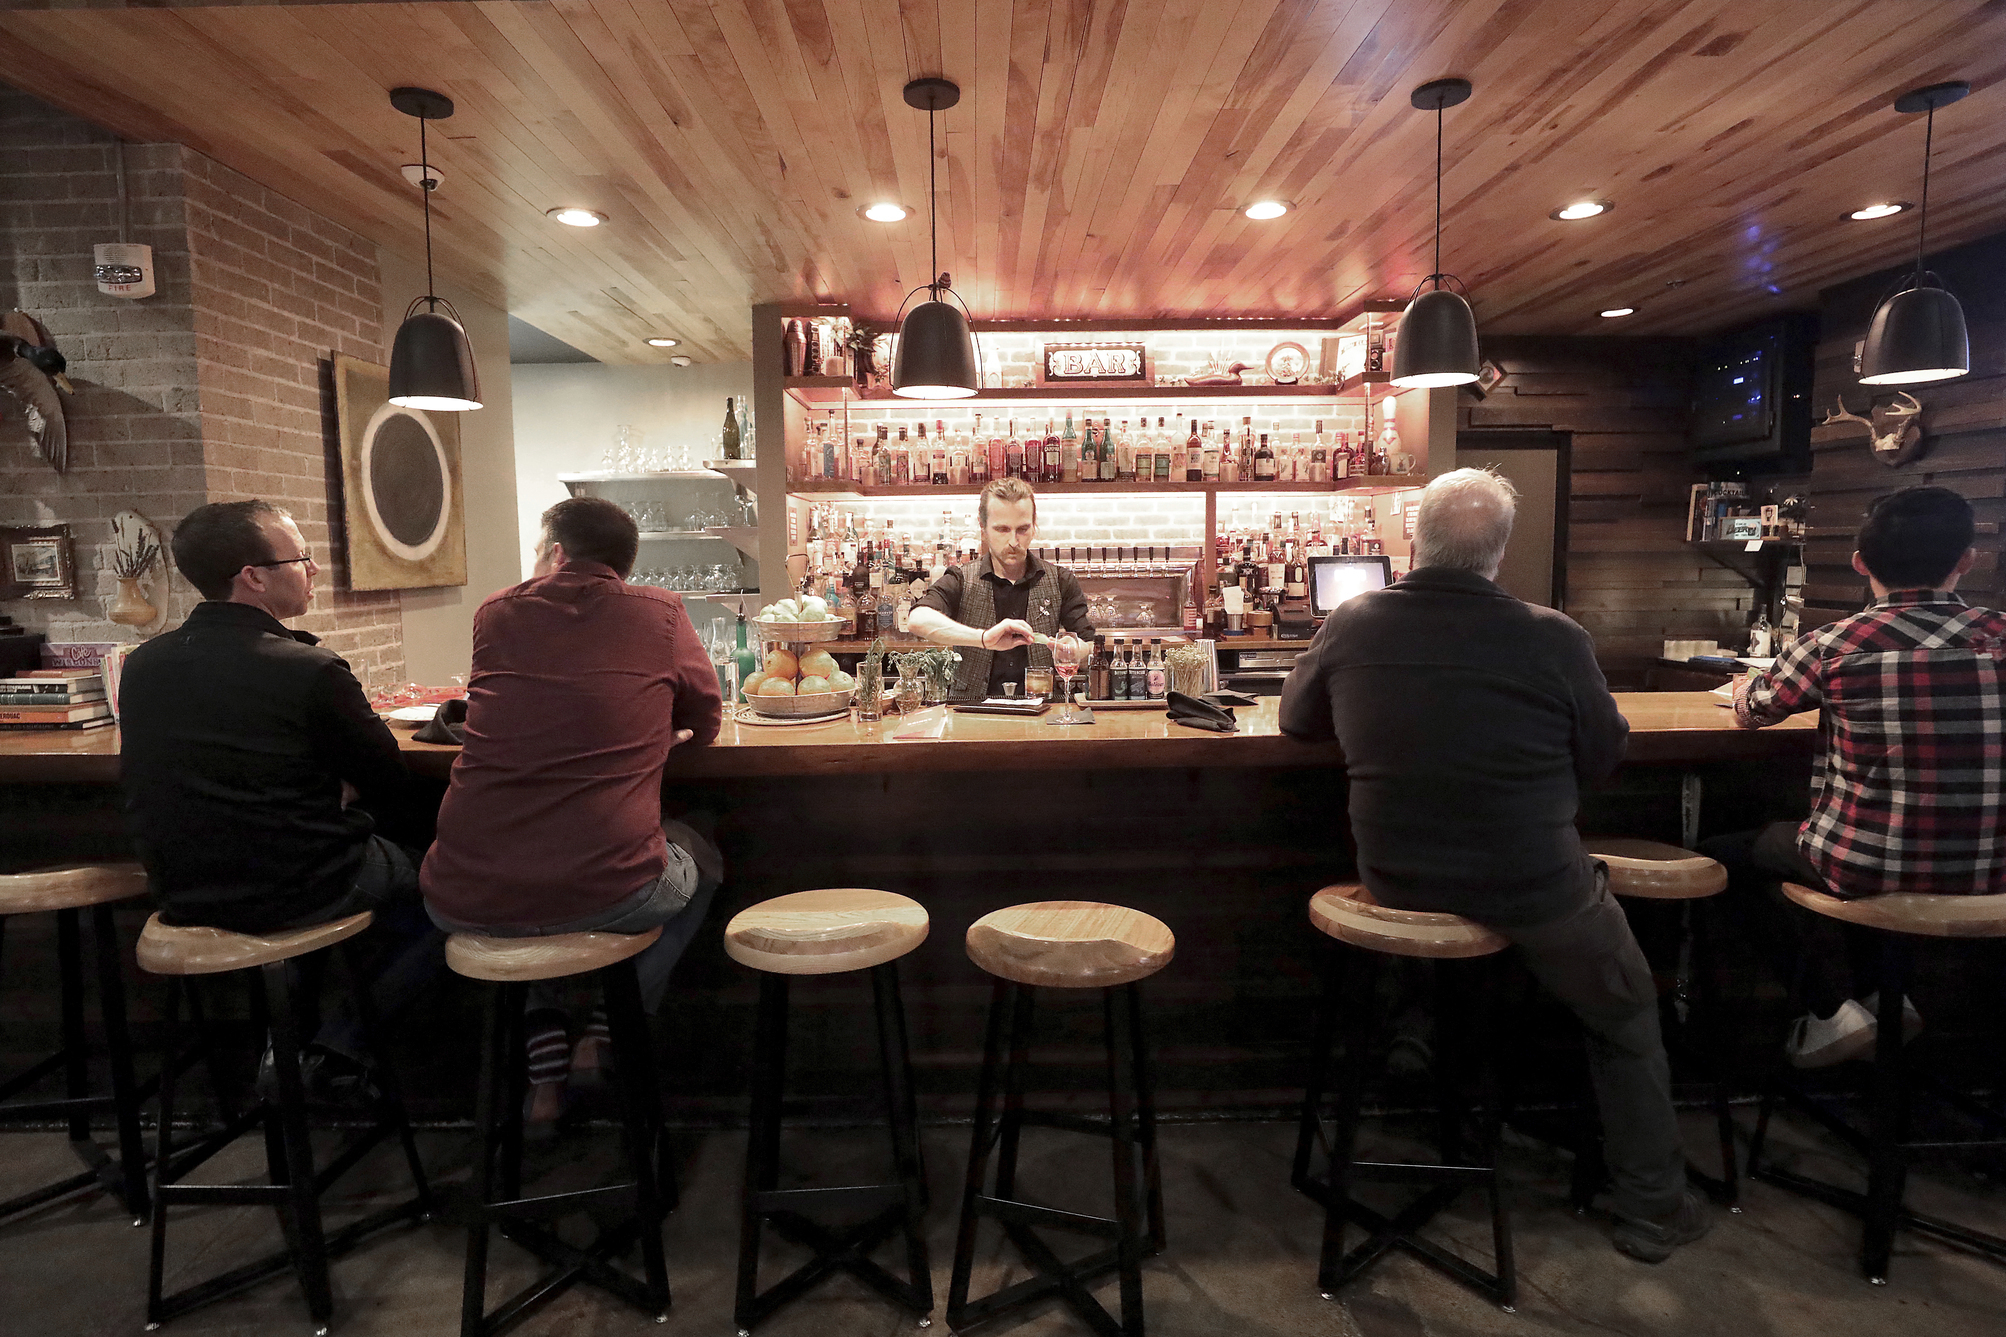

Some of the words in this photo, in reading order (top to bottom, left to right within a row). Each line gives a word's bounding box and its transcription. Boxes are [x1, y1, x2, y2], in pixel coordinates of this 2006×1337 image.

[108, 284, 132, 292] FIRE
[1063, 351, 1127, 375] BAR
[52, 658, 102, 668] WISCONS
